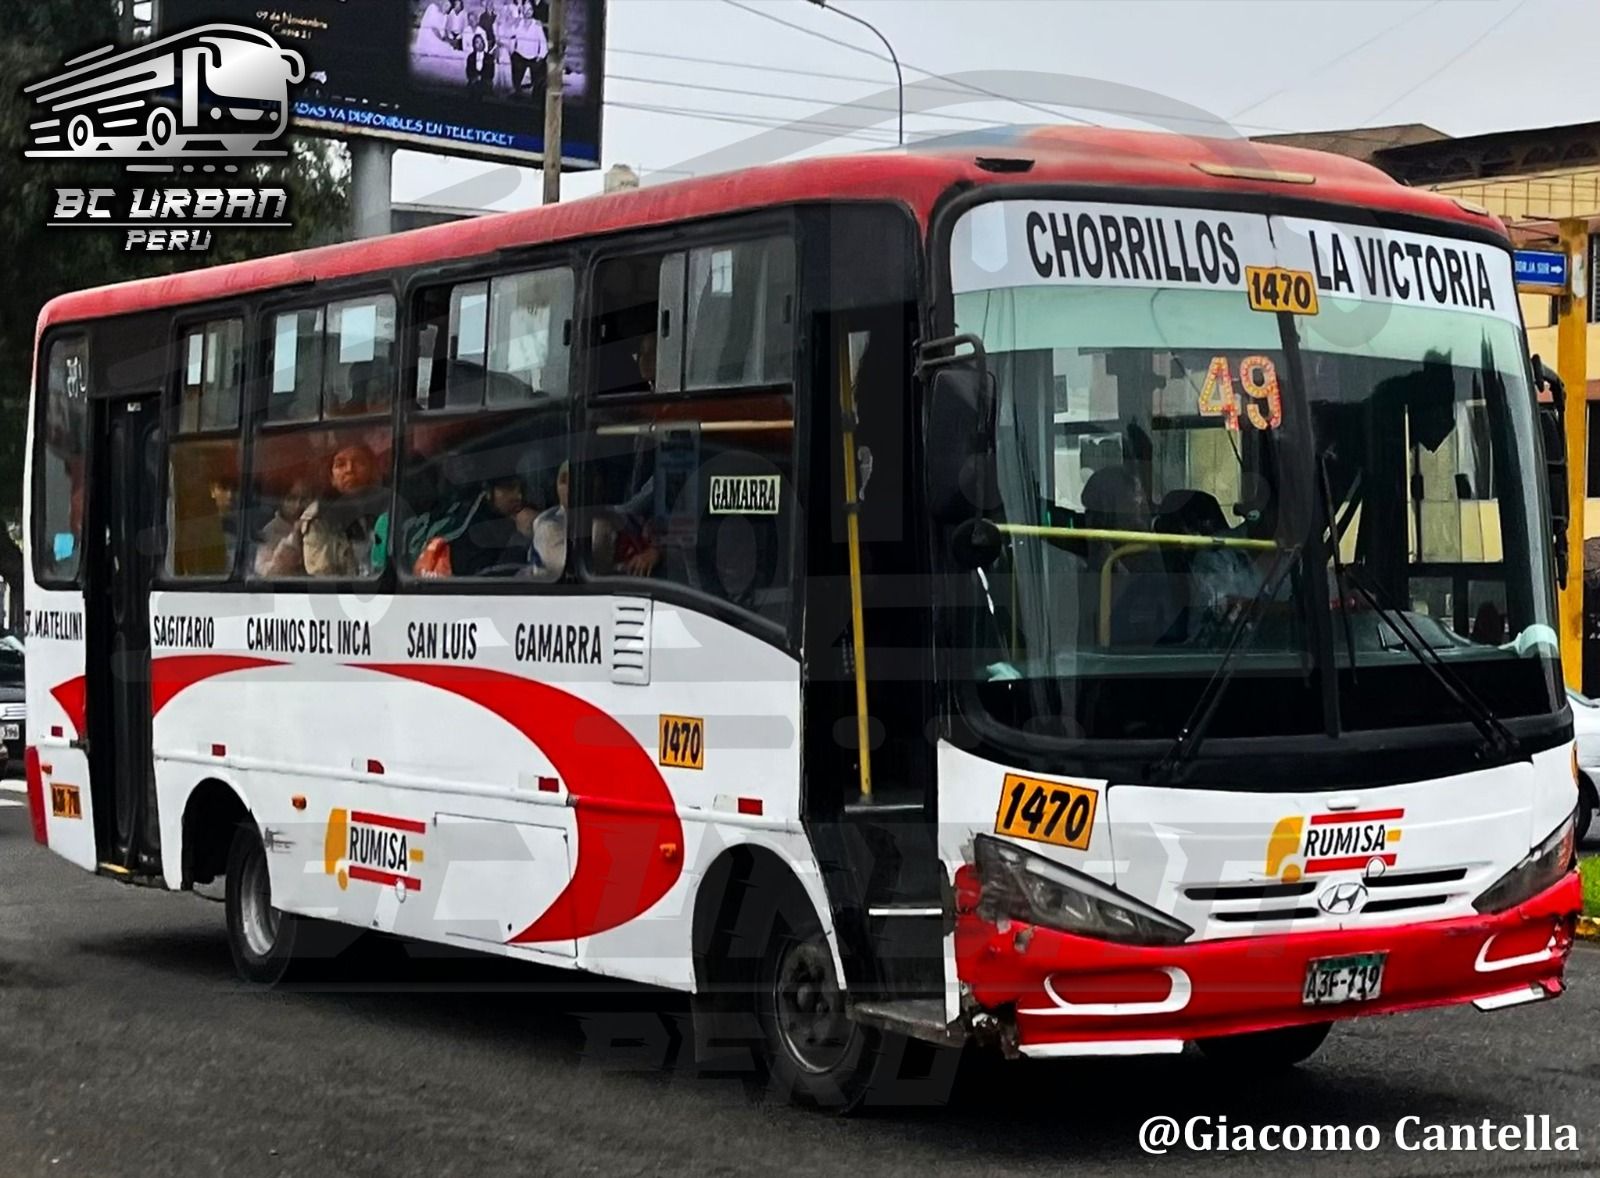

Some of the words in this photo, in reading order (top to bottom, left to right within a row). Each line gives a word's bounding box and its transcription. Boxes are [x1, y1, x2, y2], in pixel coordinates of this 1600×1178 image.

[328, 107, 346, 121] YA
[348, 110, 423, 132] DISPONIBLES
[425, 120, 443, 135] EN
[446, 126, 516, 145] TELETICKET
[1026, 211, 1240, 285] CHORRILLOS
[1308, 230, 1355, 293] LA
[1354, 236, 1495, 311] VICTORIA
[1252, 271, 1311, 309] 1470
[1199, 356, 1281, 431] 49
[712, 478, 777, 511] GAMARRA
[34, 610, 82, 640] MATELLINI
[153, 615, 214, 648] SAGITARIO
[247, 618, 306, 653] CAMINOS
[309, 619, 333, 653] DEL
[337, 620, 371, 656] INCA
[407, 622, 437, 659] SAN
[442, 622, 477, 660] LUIS
[515, 623, 602, 664] GAMARRA
[662, 719, 701, 765] 1470
[1003, 781, 1090, 842] 1470
[349, 826, 407, 871] RUMISA
[1303, 824, 1385, 857] RUMISA
[1305, 965, 1380, 999] A3F-719
